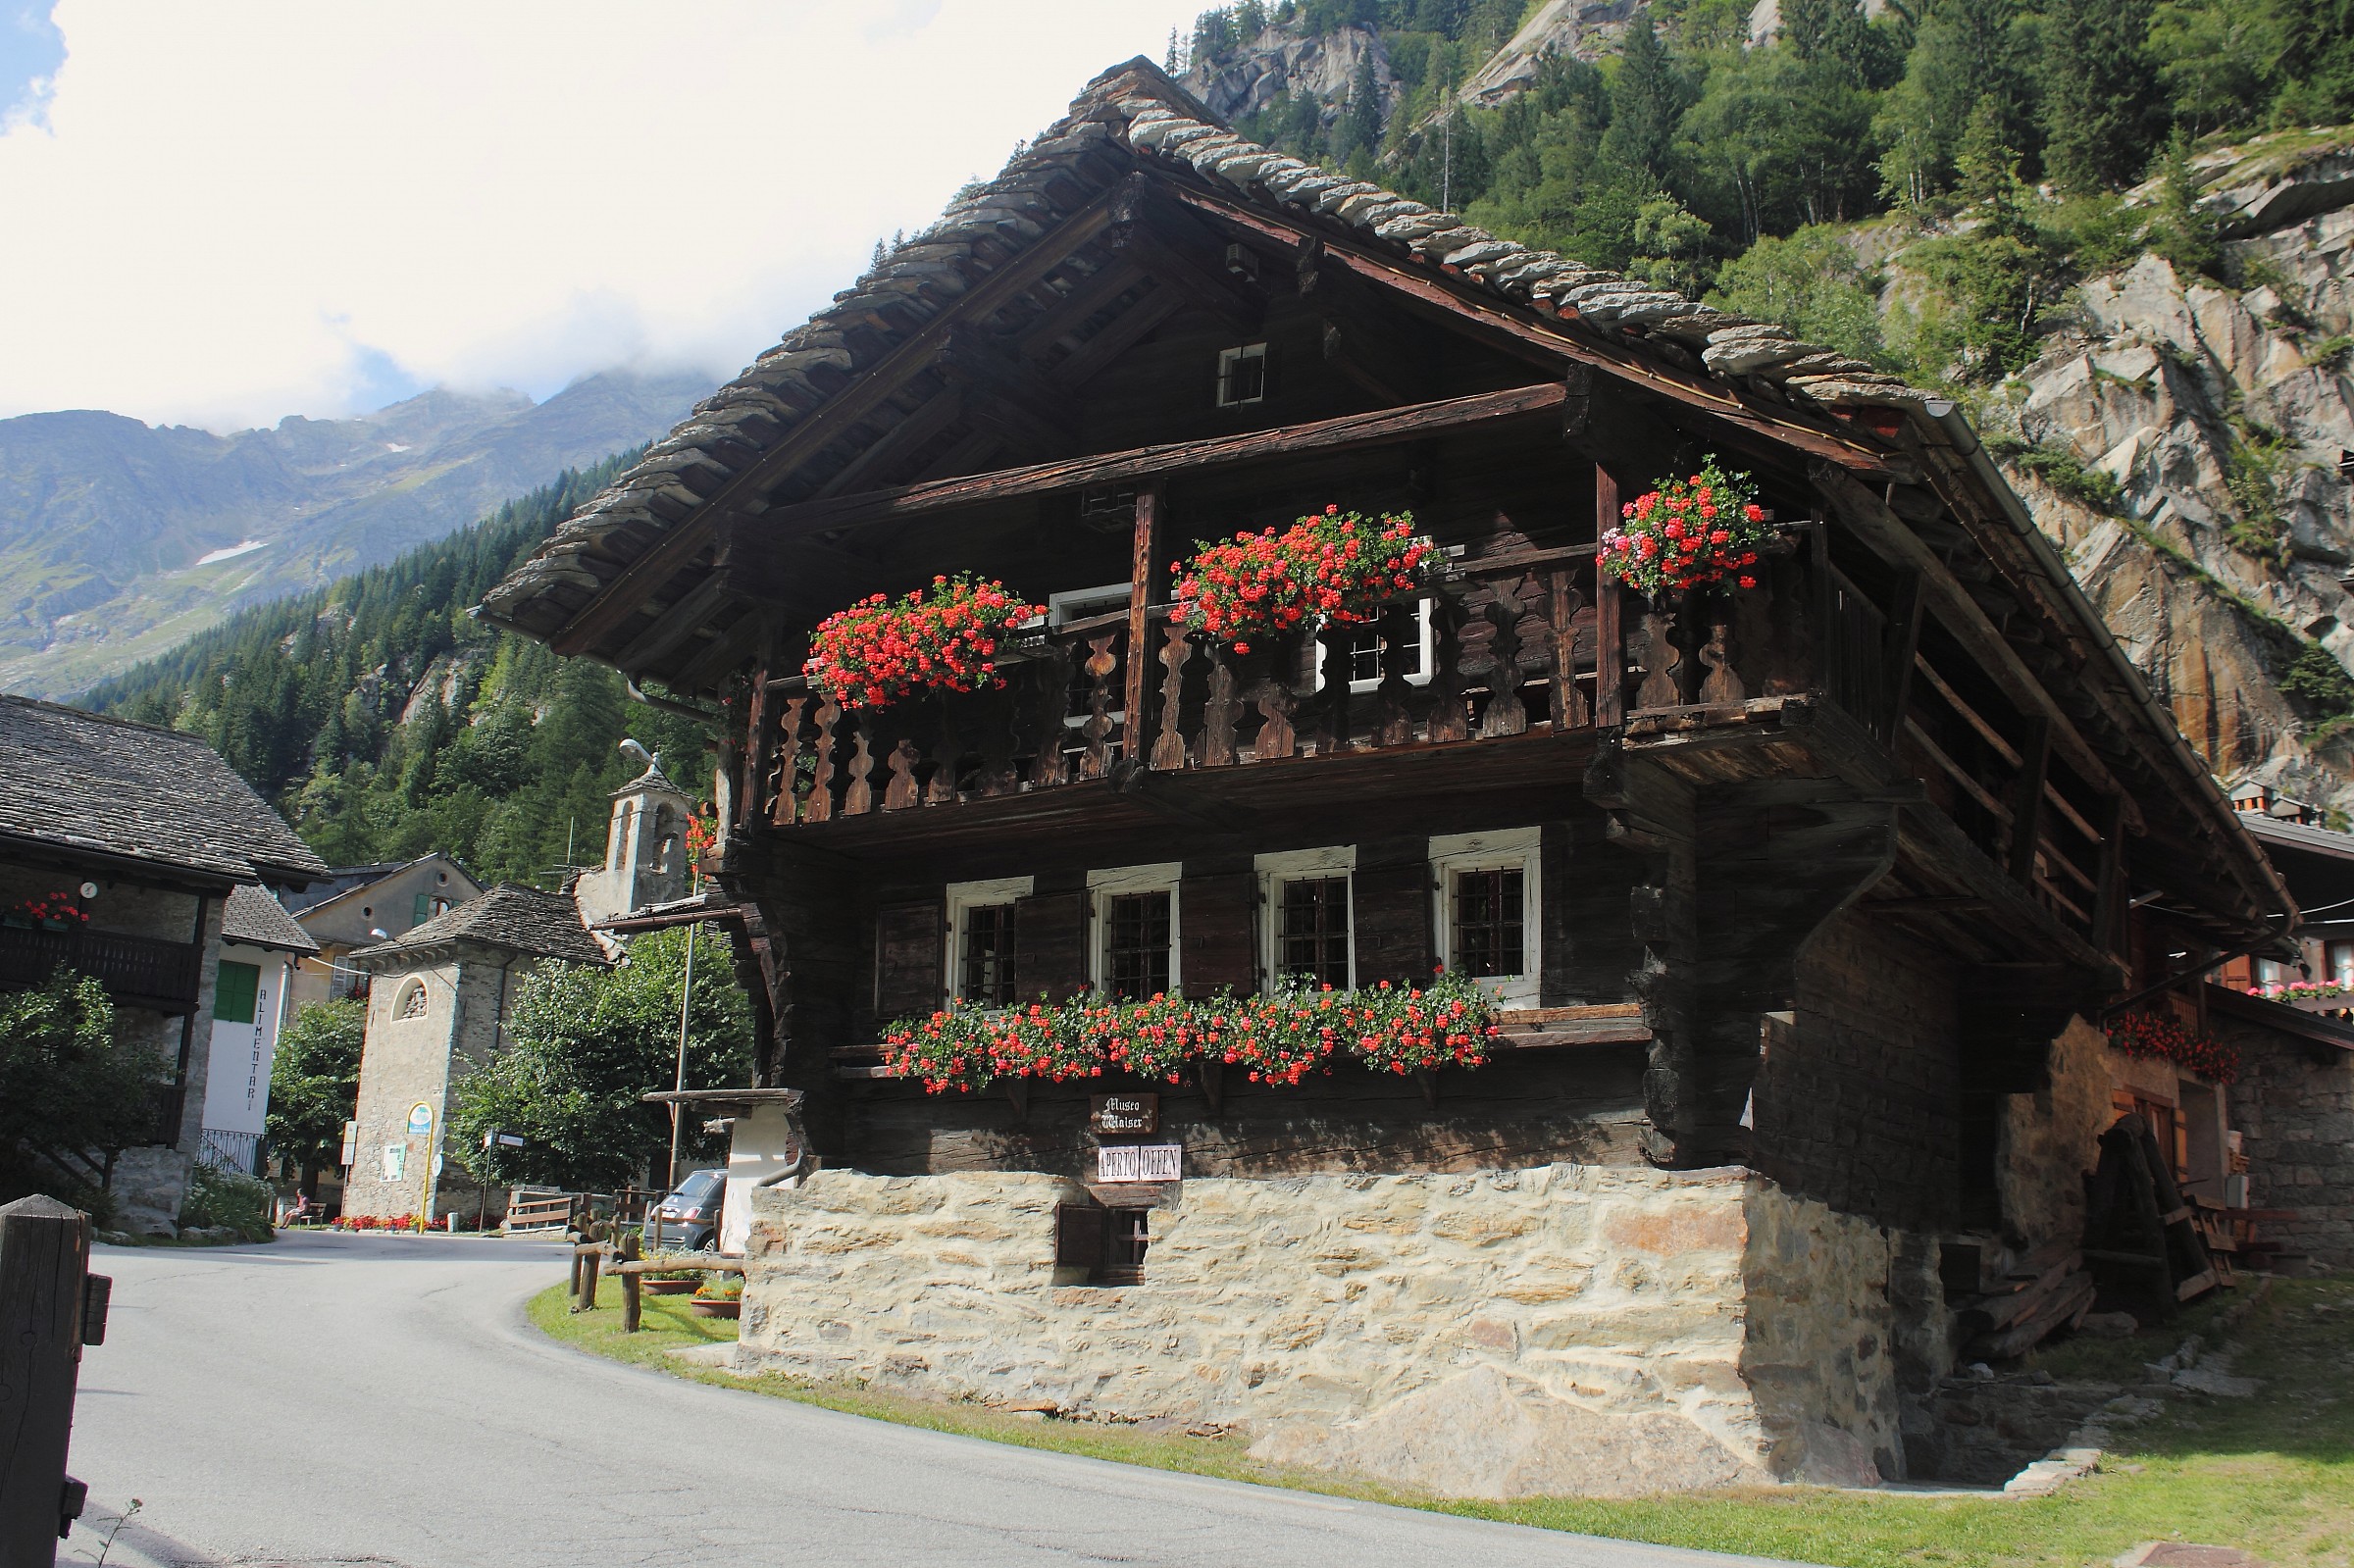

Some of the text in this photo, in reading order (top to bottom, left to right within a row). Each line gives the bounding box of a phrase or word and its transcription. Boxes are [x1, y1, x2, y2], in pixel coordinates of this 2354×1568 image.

[247, 989, 267, 1111] ALIMENTARI
[1104, 1097, 1140, 1112] Museo
[1100, 1151, 1136, 1178] APERTO
[1143, 1149, 1177, 1176] OFFEN
